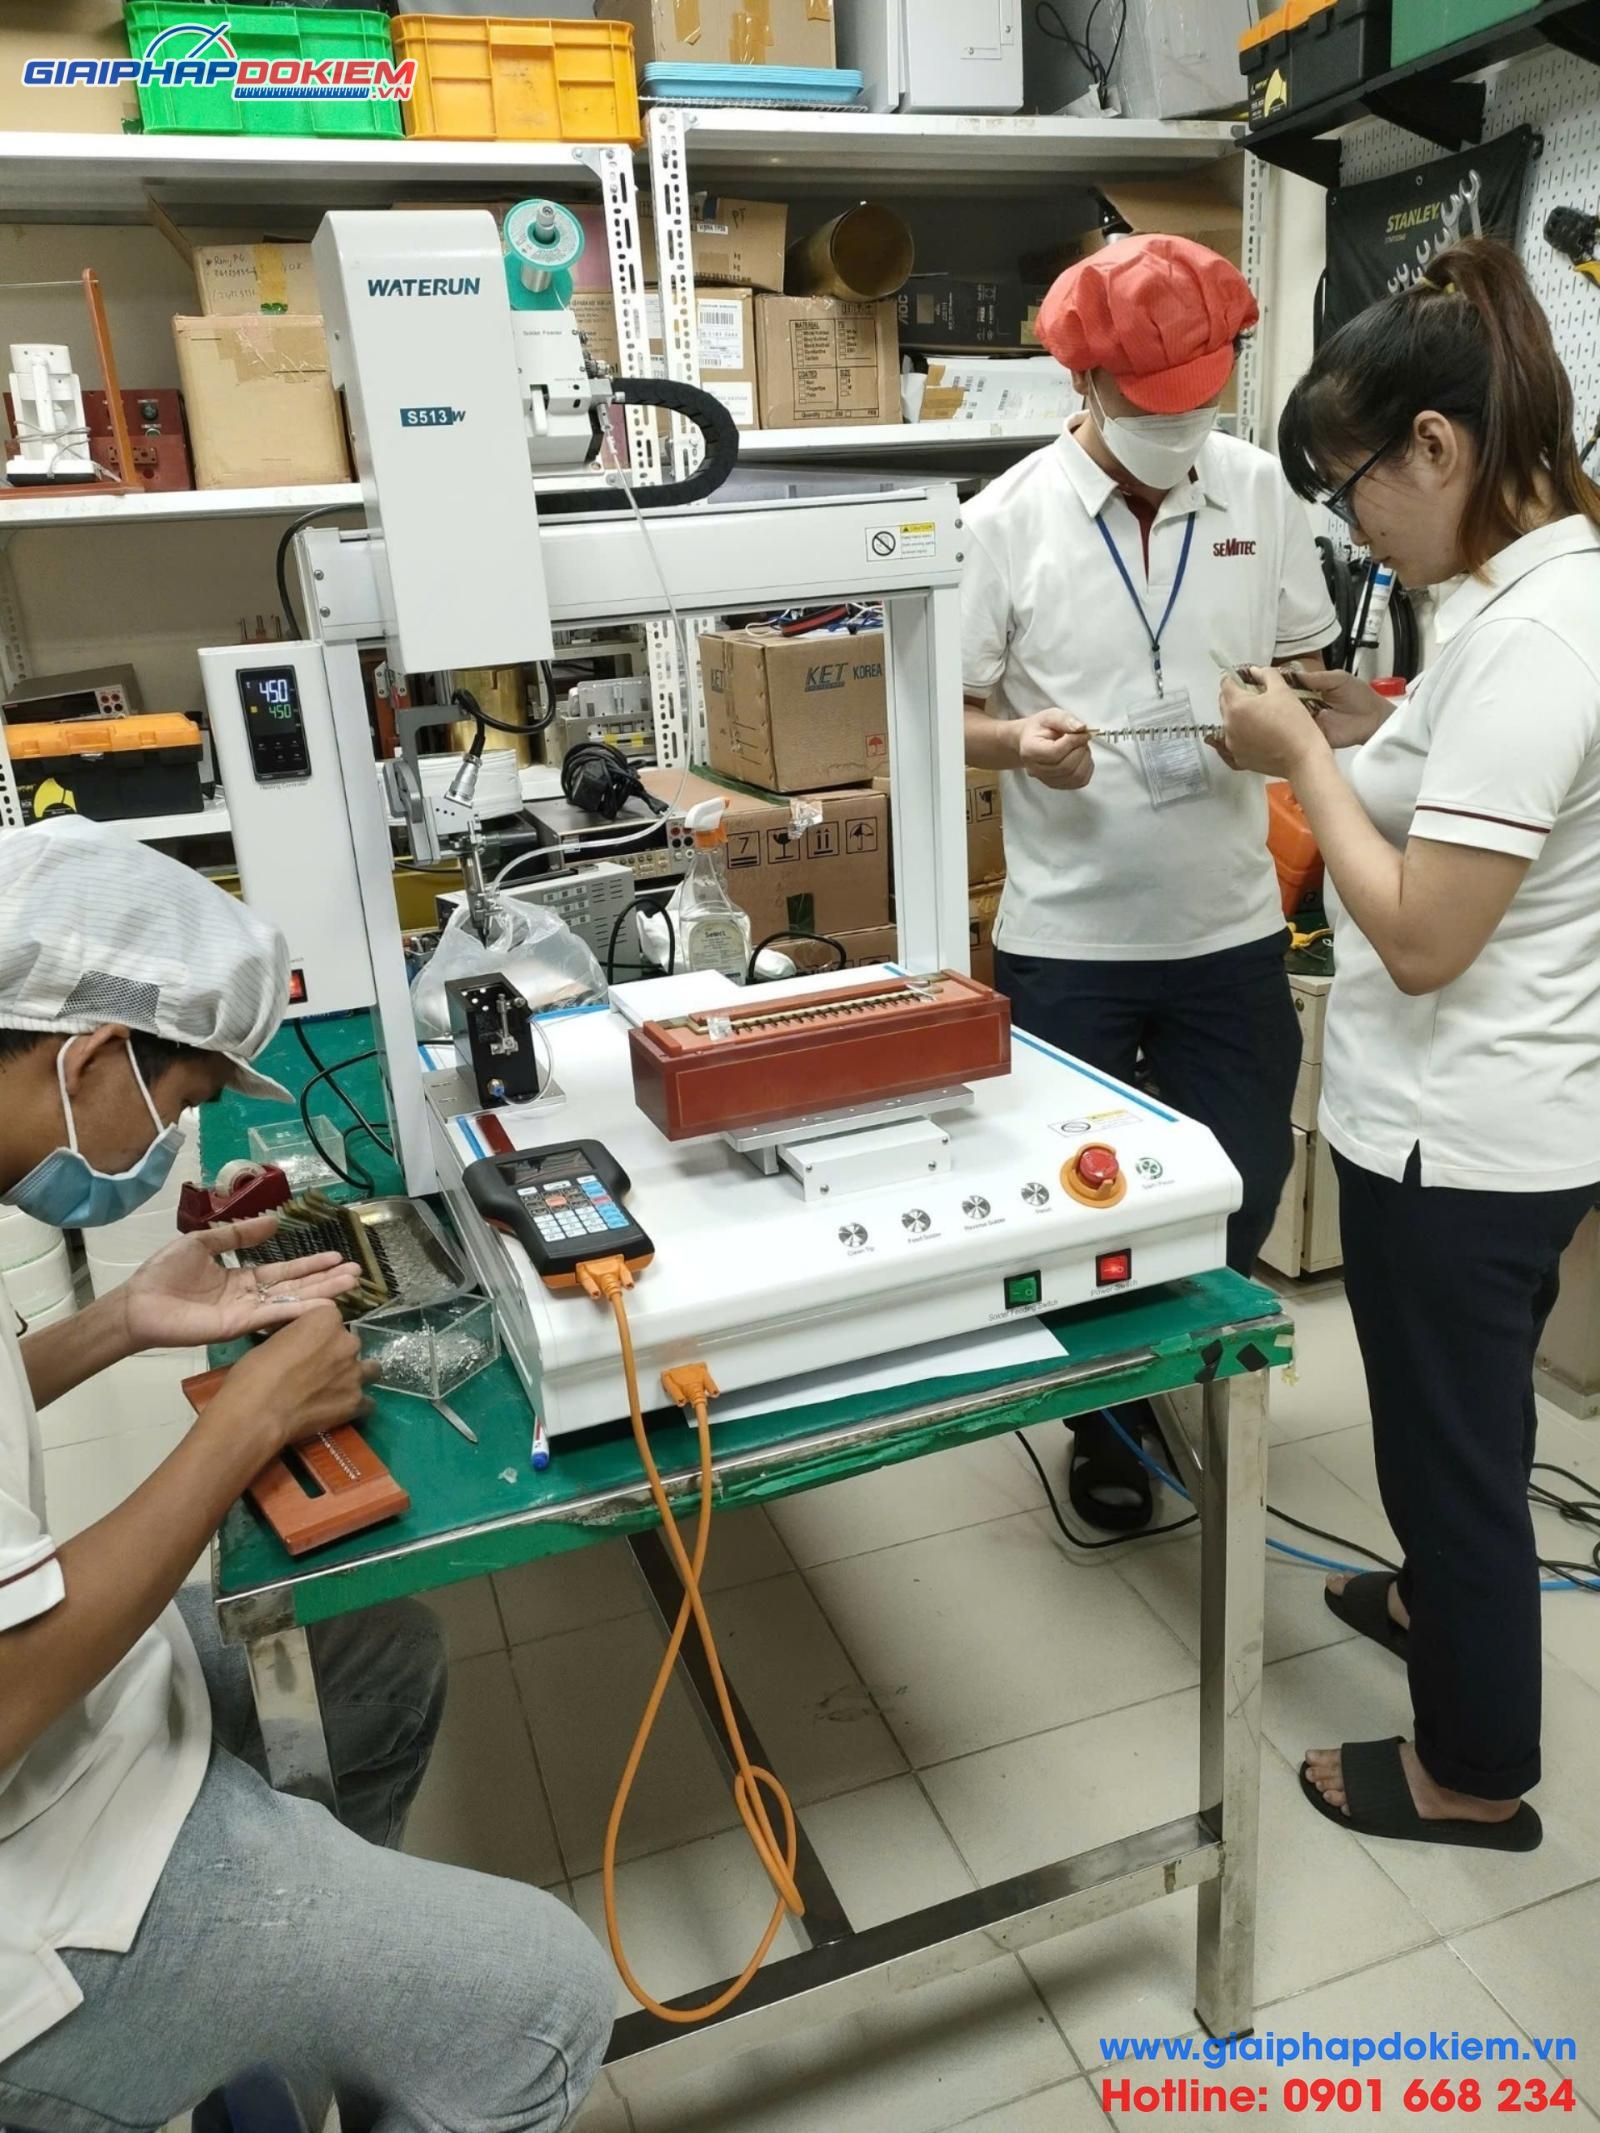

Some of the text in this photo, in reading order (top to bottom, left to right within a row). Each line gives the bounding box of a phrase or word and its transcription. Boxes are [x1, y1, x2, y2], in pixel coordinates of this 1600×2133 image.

[1385, 202, 1440, 233] STANLEY
[368, 278, 480, 297] WATERUN
[1213, 538, 1256, 557] SEMITEC
[805, 663, 883, 687] KET KOREA
[259, 679, 289, 703] 450
[269, 704, 292, 719] 450
[1090, 1279, 1138, 1297] Power Switch
